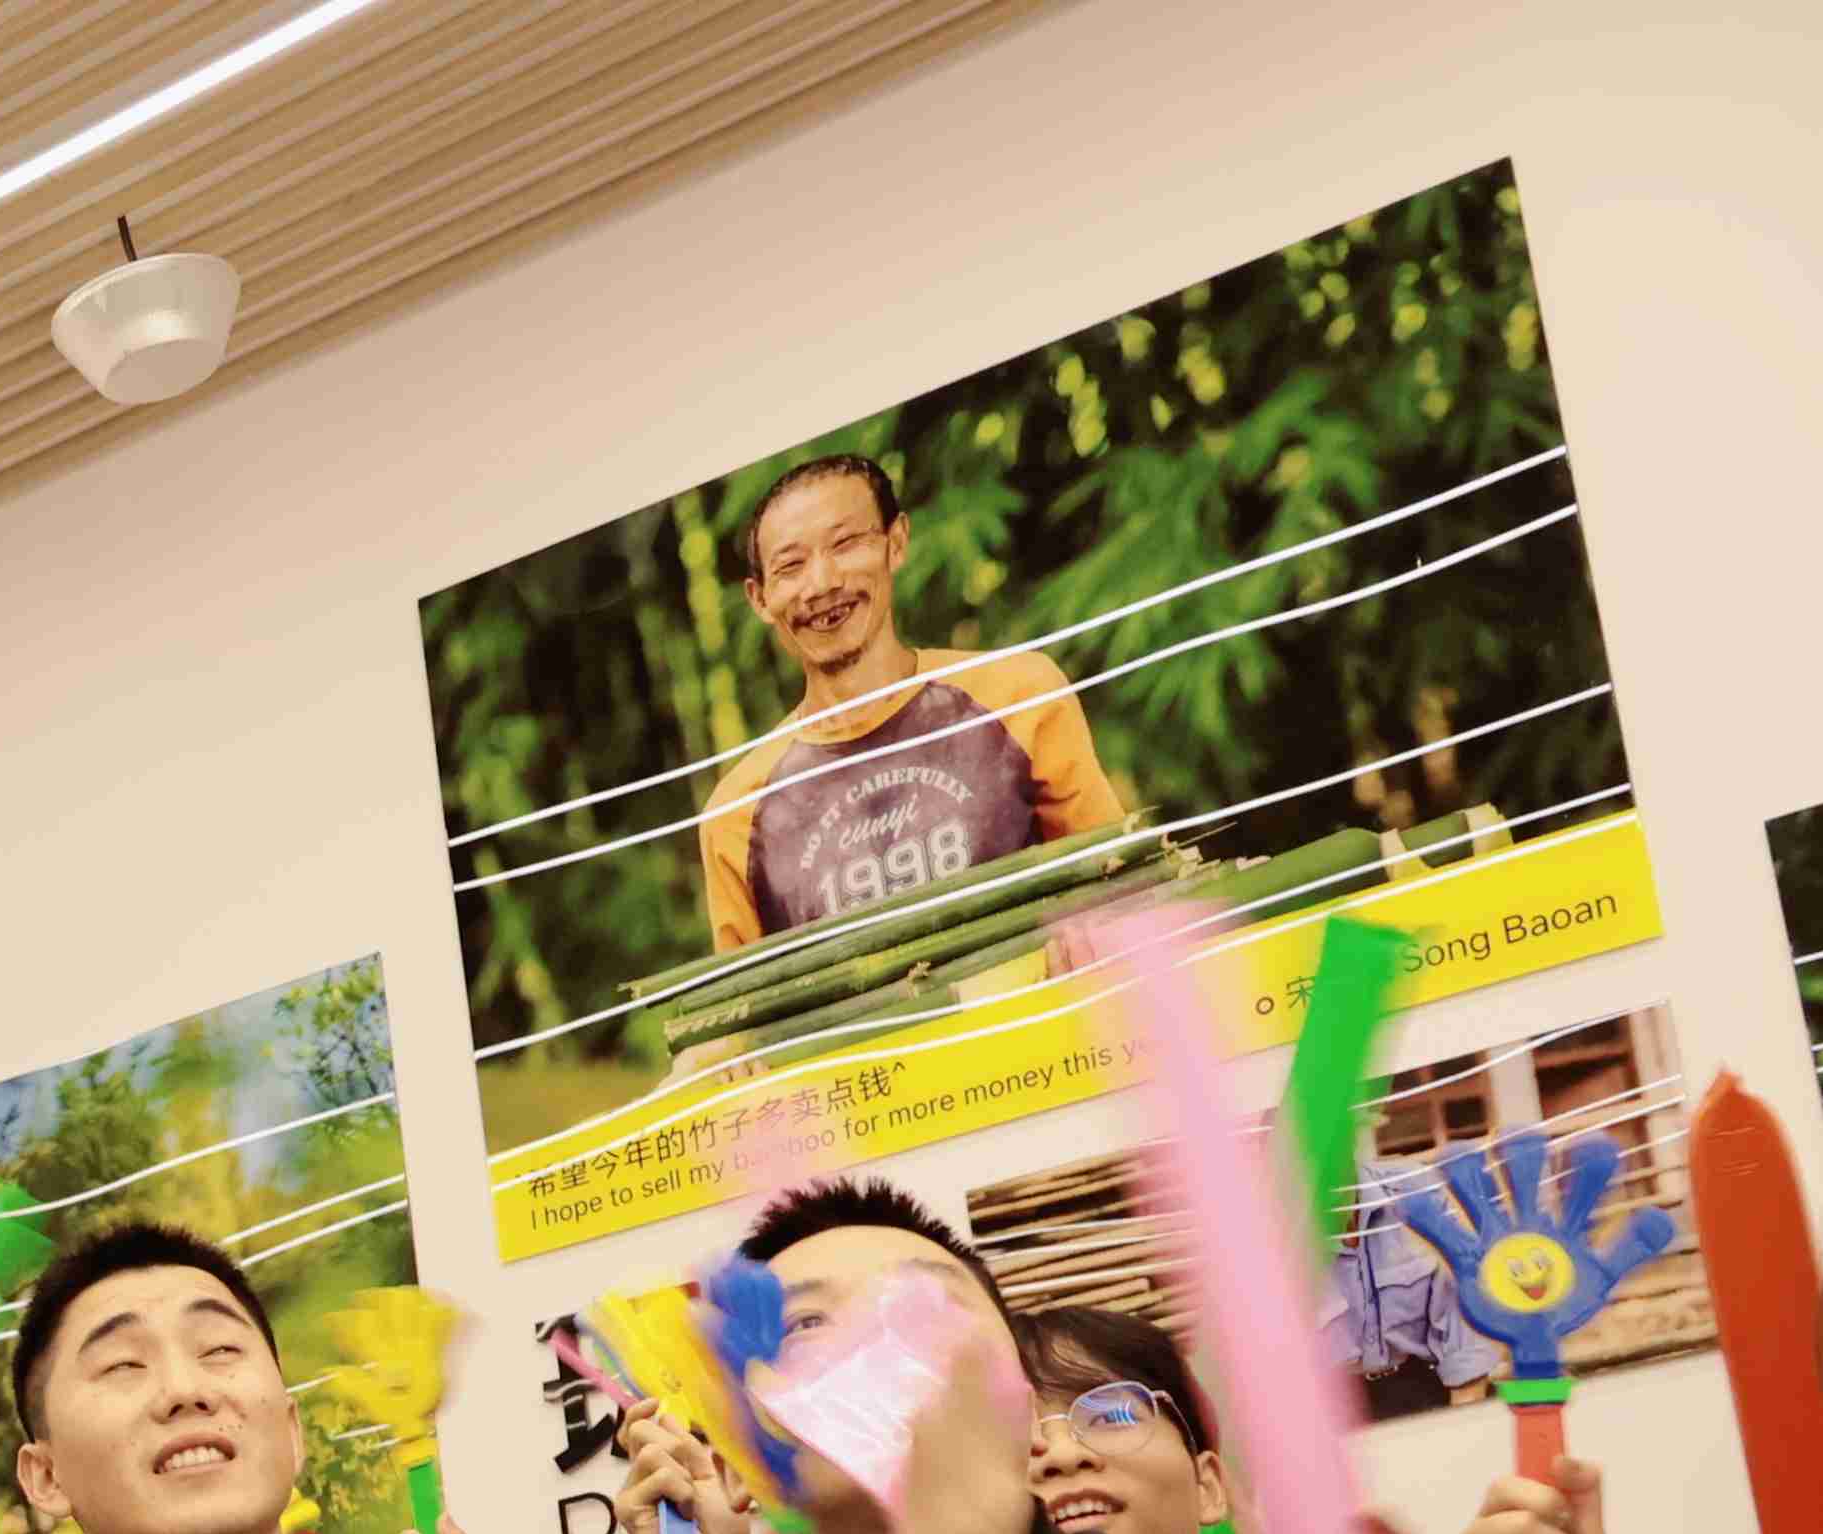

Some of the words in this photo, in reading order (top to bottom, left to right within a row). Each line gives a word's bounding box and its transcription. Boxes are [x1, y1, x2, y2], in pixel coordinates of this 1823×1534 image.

[819, 818, 972, 914] 1998
[1401, 931, 1492, 973] Song
[1501, 894, 1618, 945] Baoan
[544, 1196, 603, 1226] hope
[610, 1187, 634, 1207] to
[642, 1168, 682, 1198] sell
[689, 1159, 725, 1184] my
[843, 1113, 880, 1139] for
[888, 1093, 955, 1129] more
[963, 1063, 1054, 1106] money
[1062, 1045, 1114, 1077] this
